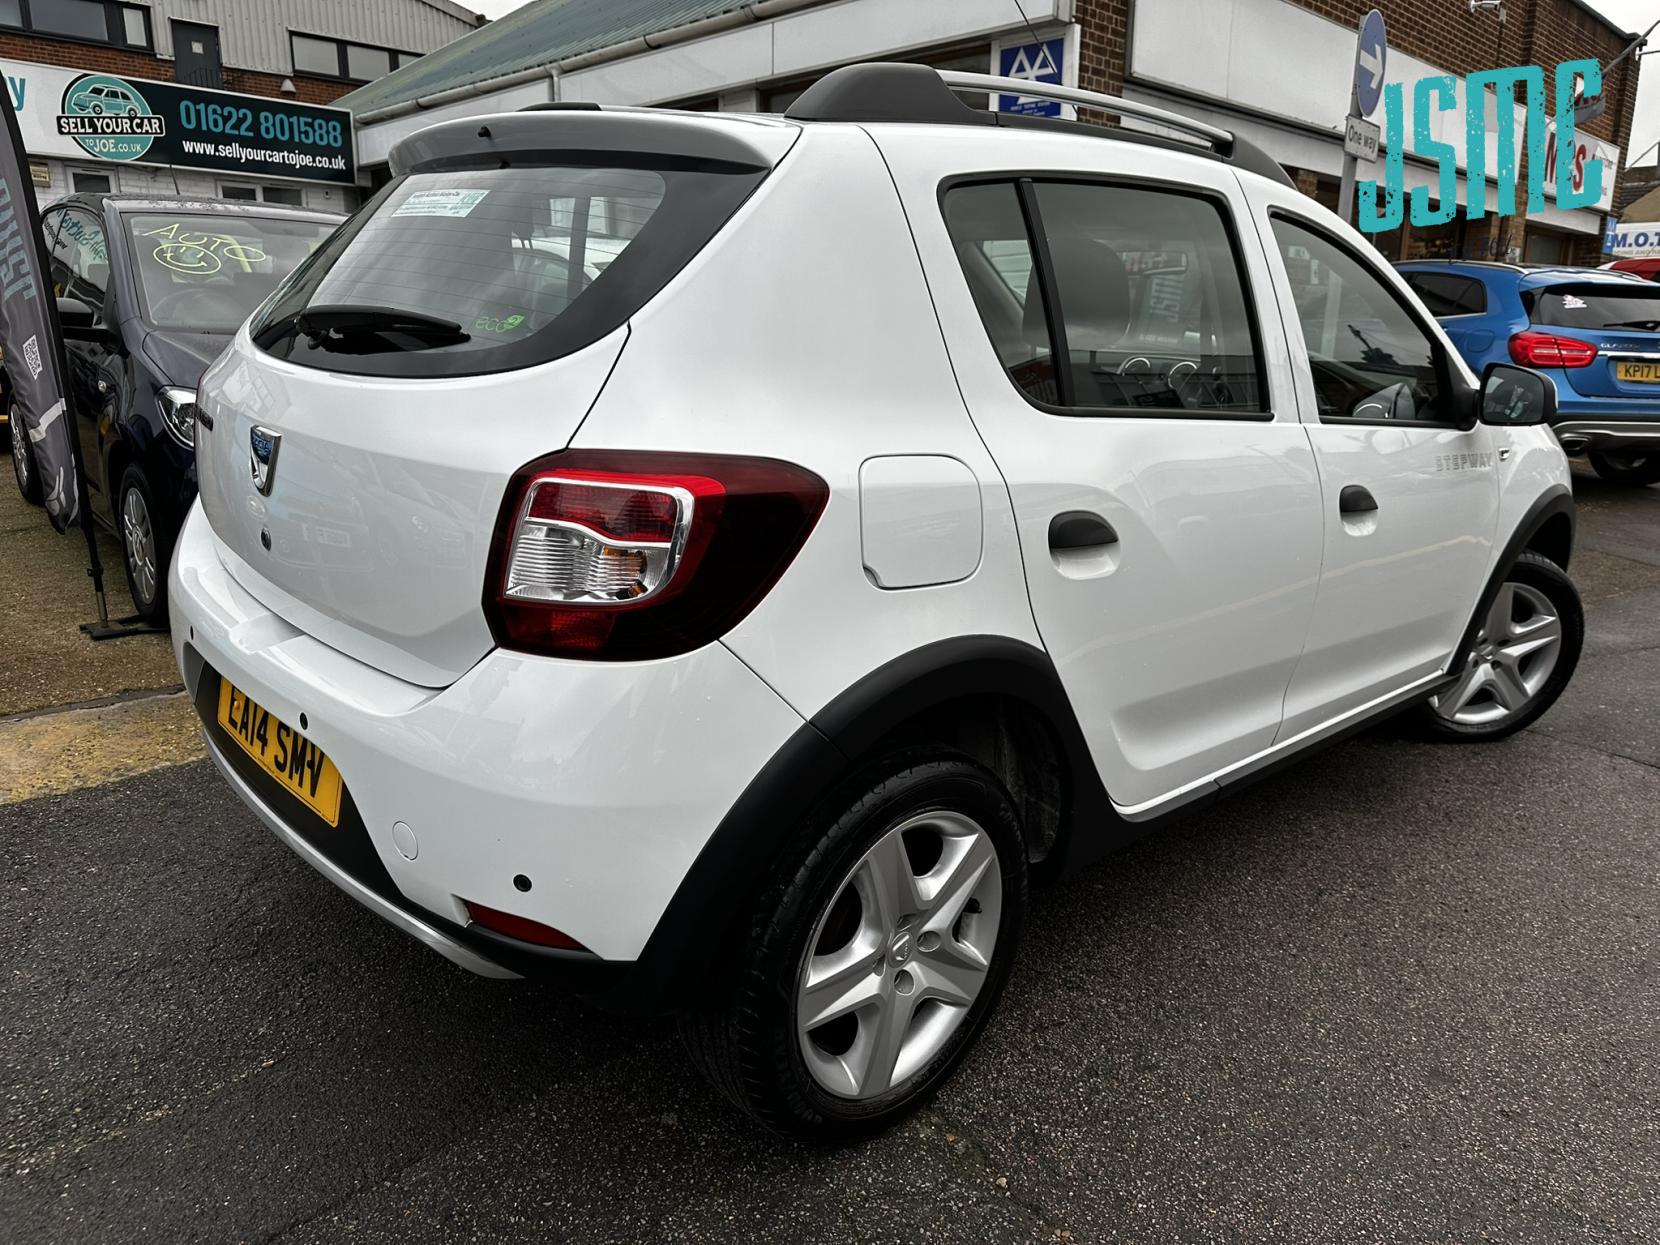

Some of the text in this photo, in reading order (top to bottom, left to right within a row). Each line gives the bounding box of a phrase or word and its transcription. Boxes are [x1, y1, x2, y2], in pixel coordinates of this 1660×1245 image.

[60, 118, 161, 133] SELL YOUR CAR
[179, 100, 343, 147] 01622 801588
[1348, 124, 1377, 154] One way
[182, 140, 347, 170] www.sellyourcartojoe.co.uk
[141, 223, 266, 262] AUTO
[1624, 363, 1653, 379] KP17
[228, 684, 326, 798] EA14 SMV
